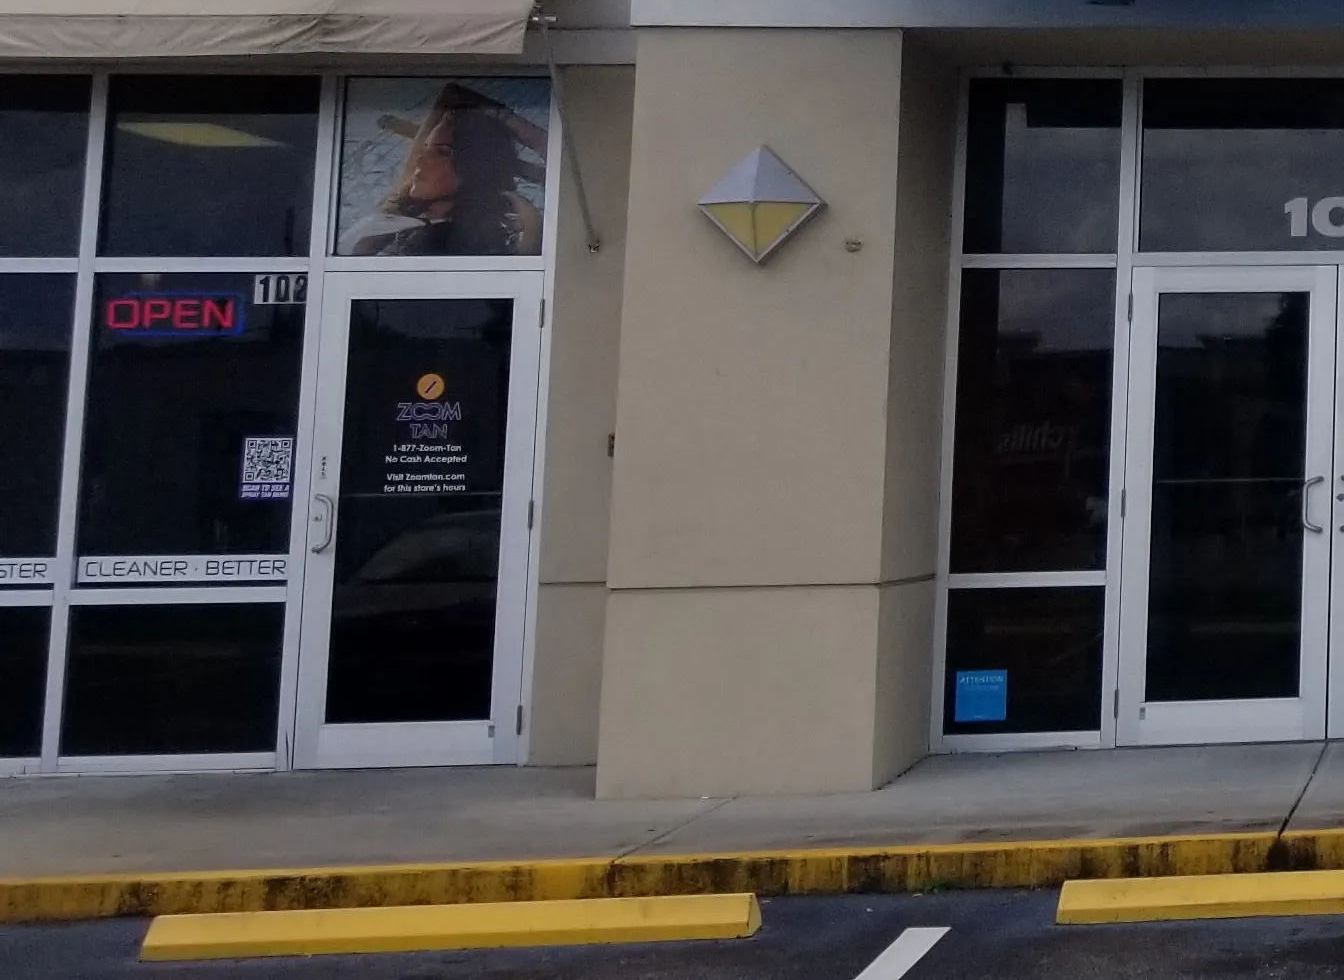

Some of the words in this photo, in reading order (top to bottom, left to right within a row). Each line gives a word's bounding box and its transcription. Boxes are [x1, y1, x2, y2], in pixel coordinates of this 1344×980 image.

[259, 274, 308, 303] 102
[106, 299, 236, 329] OPEN
[396, 402, 462, 421] ZOOM
[410, 423, 448, 439] TAN
[385, 455, 398, 463] No
[400, 455, 422, 463] Cash
[423, 455, 468, 464] Accepted
[384, 484, 396, 492] for
[442, 484, 466, 492] hours
[85, 560, 188, 577] CLEANER
[205, 559, 287, 576] BETTER
